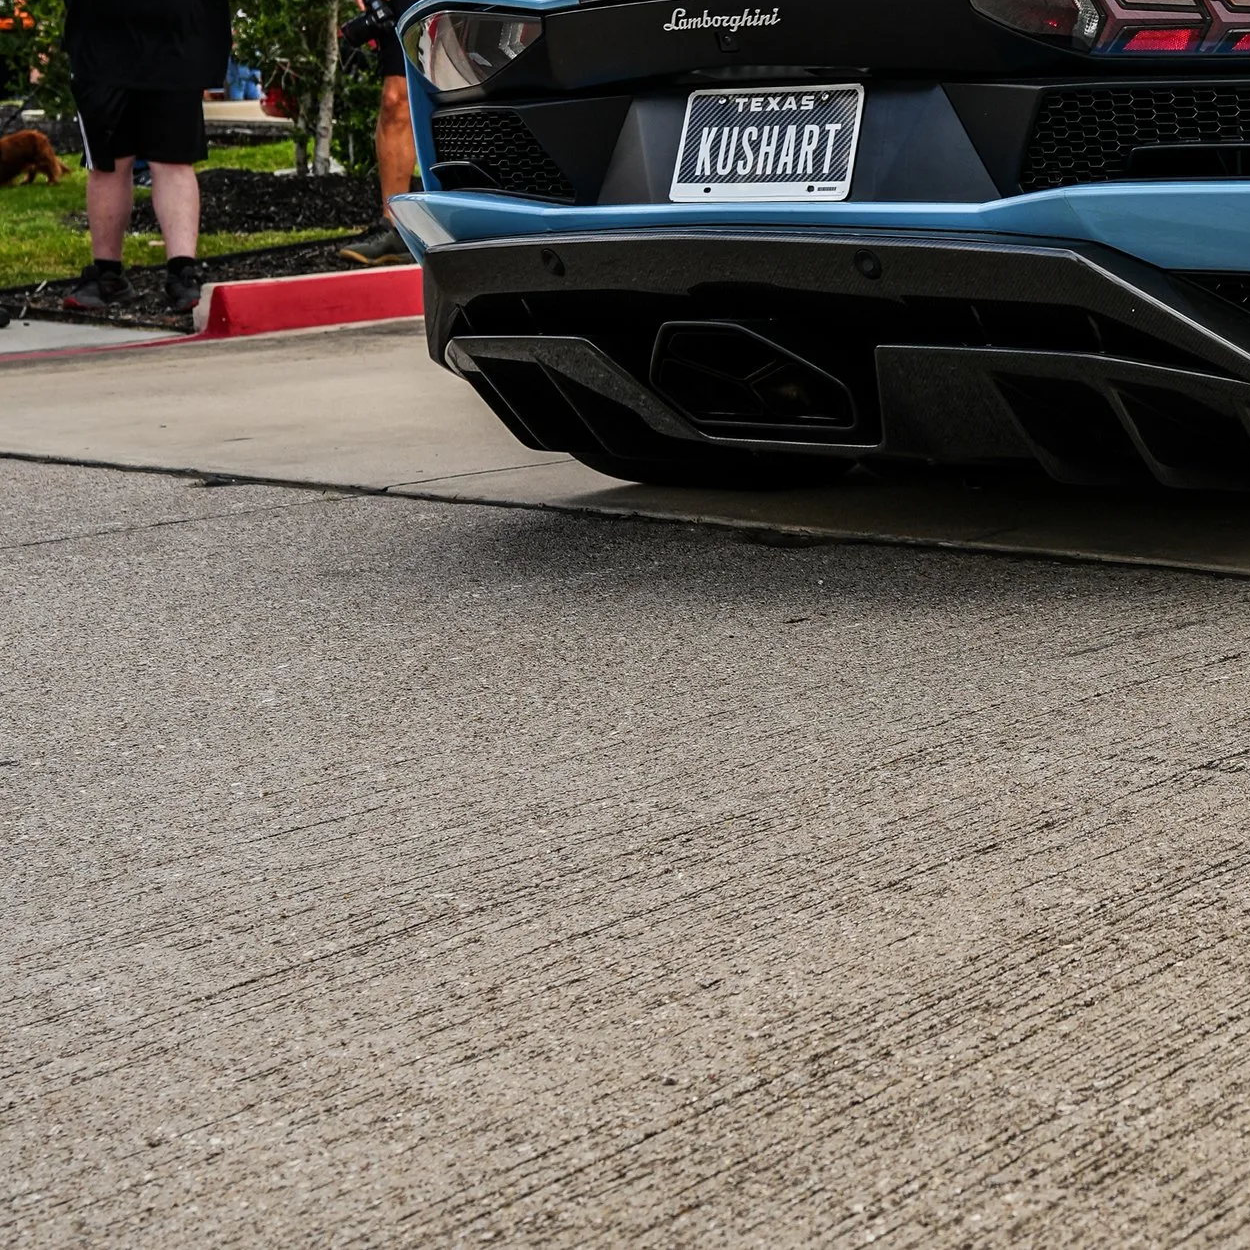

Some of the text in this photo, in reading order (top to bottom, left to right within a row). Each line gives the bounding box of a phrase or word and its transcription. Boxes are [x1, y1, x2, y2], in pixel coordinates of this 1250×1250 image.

[663, 8, 781, 32] Lamborghini
[735, 96, 814, 112] TEXAS
[695, 123, 841, 176] KUSHART
